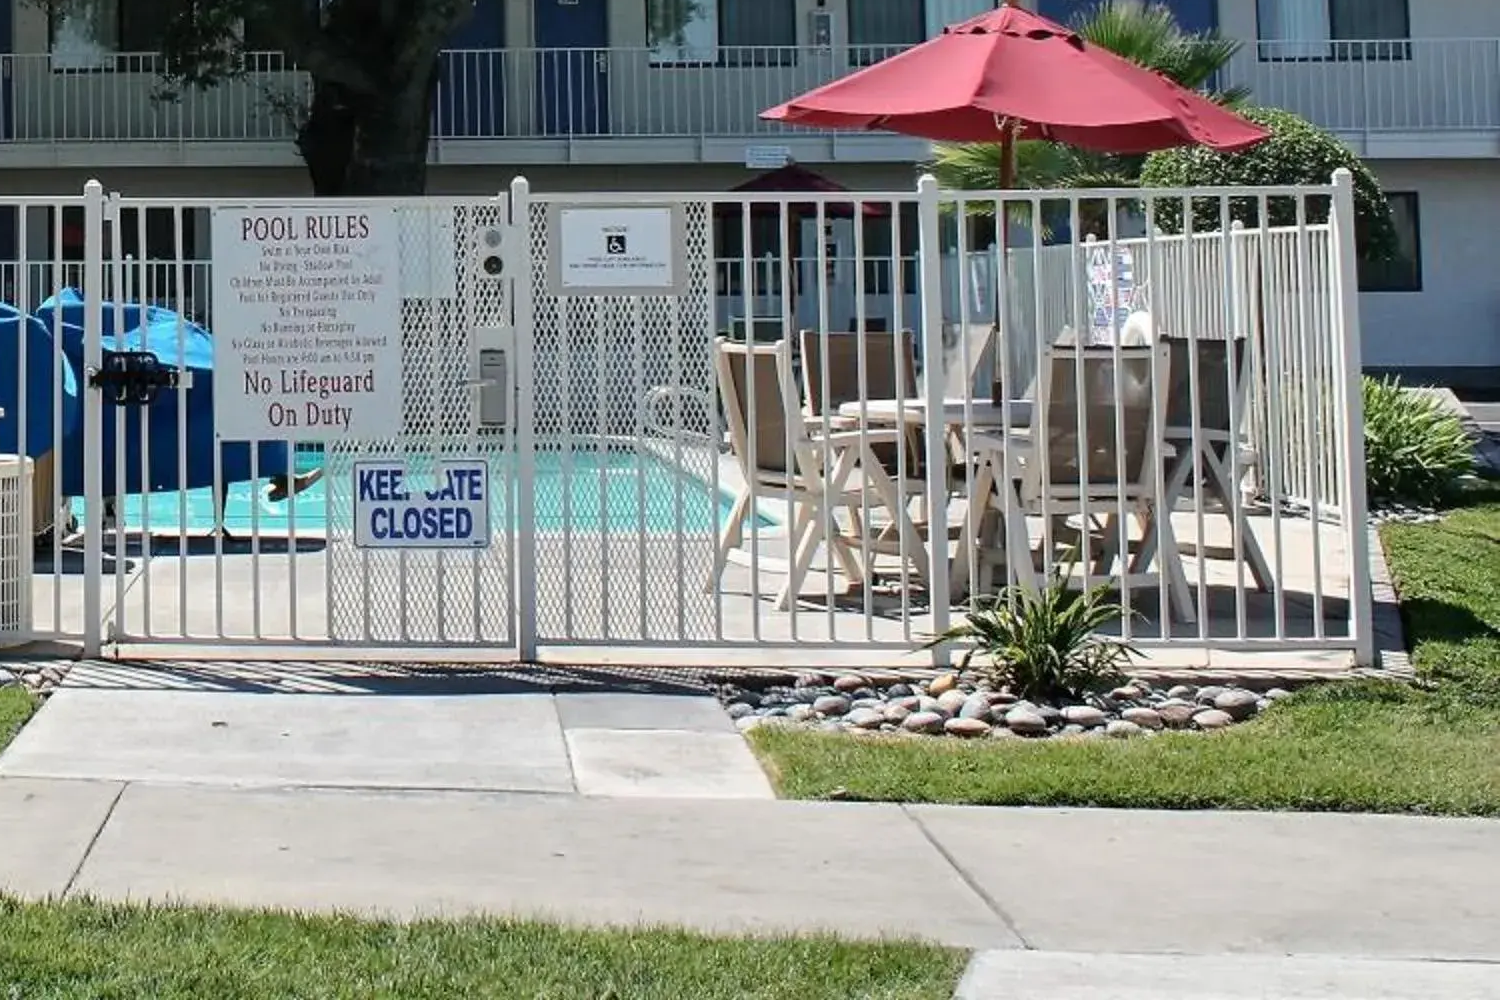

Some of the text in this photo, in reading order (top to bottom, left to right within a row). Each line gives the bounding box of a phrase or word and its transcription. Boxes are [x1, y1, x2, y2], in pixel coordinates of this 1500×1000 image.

[242, 215, 369, 240] POOL RULES
[244, 369, 375, 399] No Lifeguard
[268, 402, 352, 431] On Duty
[359, 470, 482, 501] KEE ATE
[371, 507, 473, 539] CLOSED
